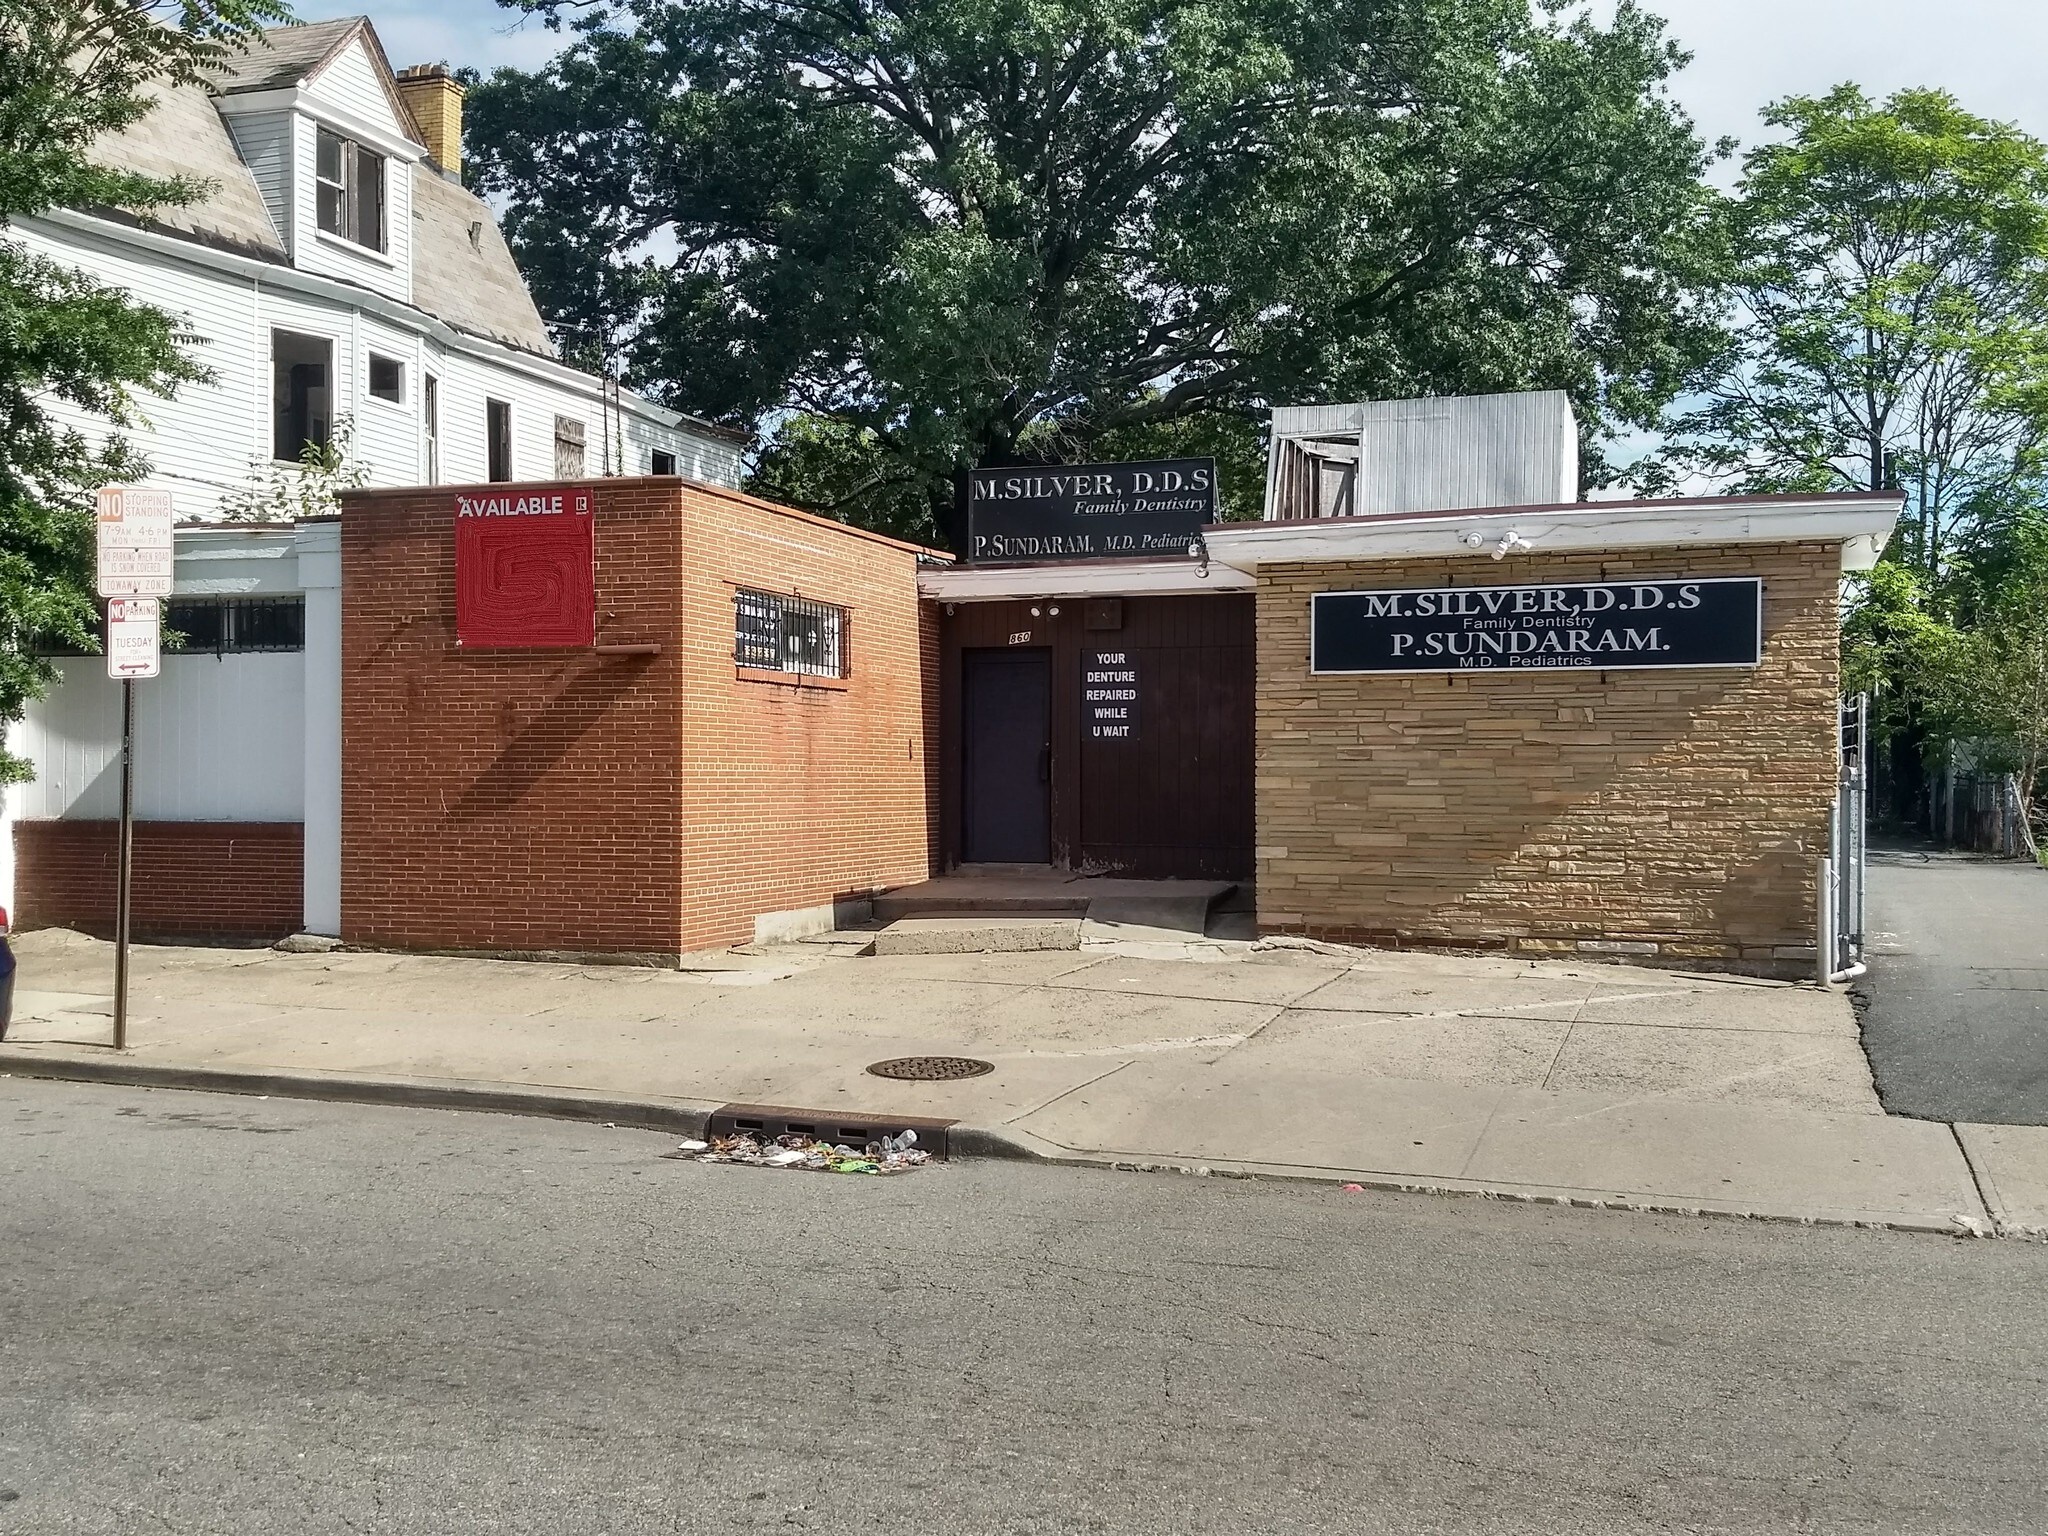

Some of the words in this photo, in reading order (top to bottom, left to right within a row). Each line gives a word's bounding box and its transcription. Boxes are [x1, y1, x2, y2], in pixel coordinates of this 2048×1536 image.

[973, 473, 1122, 500] M.SILVER,
[1132, 469, 1210, 494] D.D.S
[100, 493, 122, 517] NO
[125, 495, 169, 506] STOPPING
[458, 496, 563, 517] AVAILABLE
[1073, 499, 1129, 515] Family
[1133, 497, 1207, 512] Dentistry
[125, 507, 169, 517] STANDING
[1104, 535, 1135, 550] M.D.
[103, 552, 110, 561] NO
[113, 552, 135, 561] PARKING
[137, 552, 152, 561] WHEN
[155, 552, 169, 561] ROAD
[111, 563, 117, 573] IS
[119, 563, 134, 573] SNOW
[137, 563, 161, 573] COVERED
[106, 580, 141, 590] TOWAWAY
[145, 580, 166, 590] ZONE
[111, 604, 125, 619] NO
[126, 605, 156, 616] PARKING
[1463, 617, 1516, 630] Family
[1522, 616, 1596, 629] Dentistry
[115, 637, 153, 648] TUESDAY
[1010, 632, 1030, 643] 860
[1390, 627, 1671, 656] P.SUNDARAM.
[1097, 653, 1126, 664] YOUR
[1459, 656, 1497, 668] M.D.
[1509, 655, 1592, 666] Pediatrics
[1087, 671, 1135, 682] DENTURE
[1086, 689, 1136, 701] REPAIRED
[1094, 707, 1128, 719] WHILE
[1092, 726, 1100, 737] U
[1103, 726, 1130, 737] WAIT
